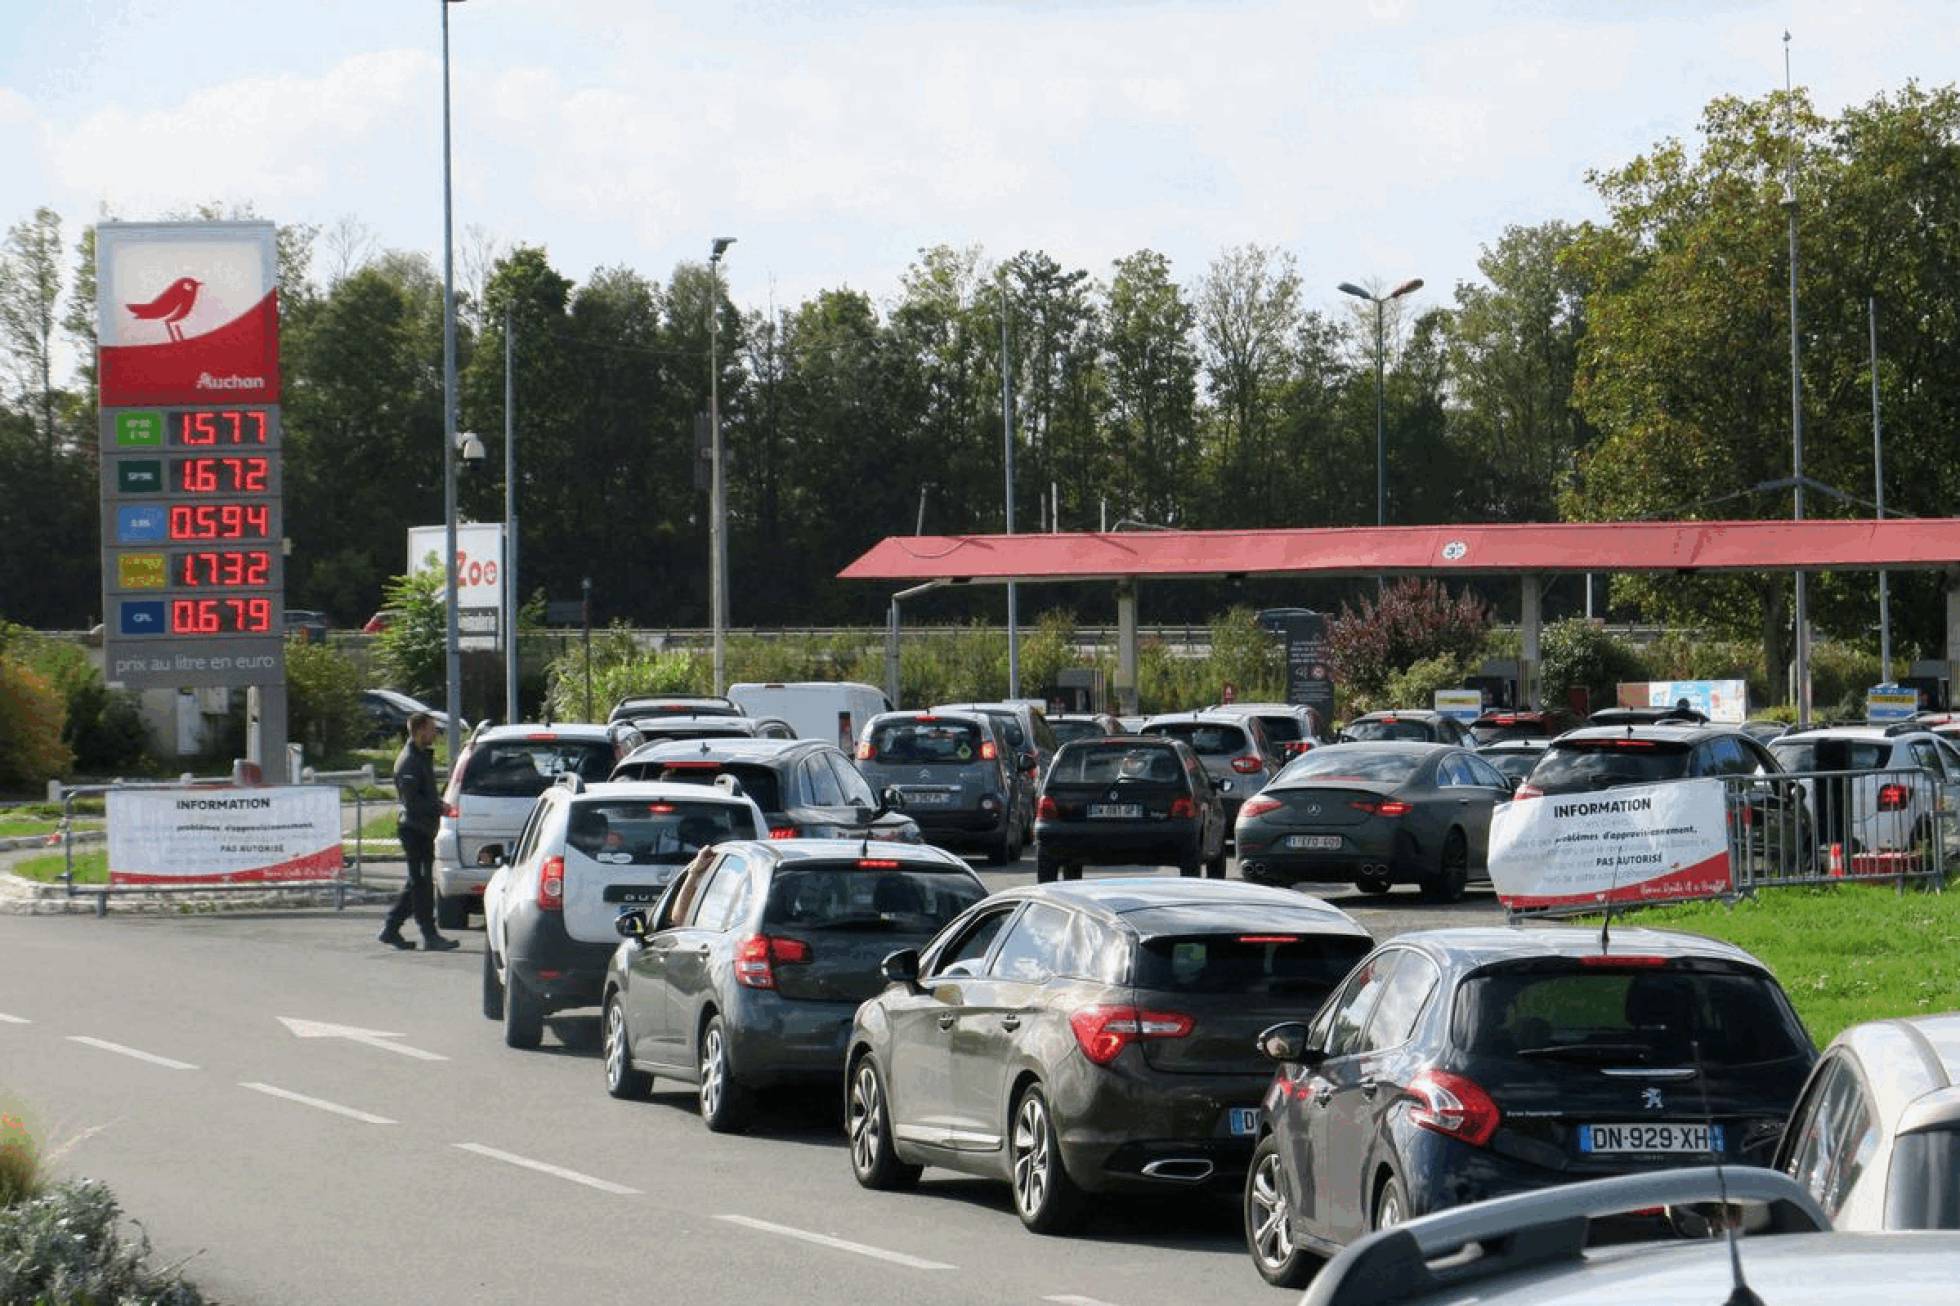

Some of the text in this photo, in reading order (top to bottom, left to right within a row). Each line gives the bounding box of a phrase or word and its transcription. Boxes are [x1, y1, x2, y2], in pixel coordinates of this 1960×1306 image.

[196, 372, 265, 389] Auchan
[115, 653, 274, 677] prix au litre en euro
[176, 798, 271, 811] INFORMATION
[1553, 797, 1653, 819] INFORMATION
[1596, 856, 1614, 867] PAS
[1593, 1126, 1708, 1150] DN-929-XH
